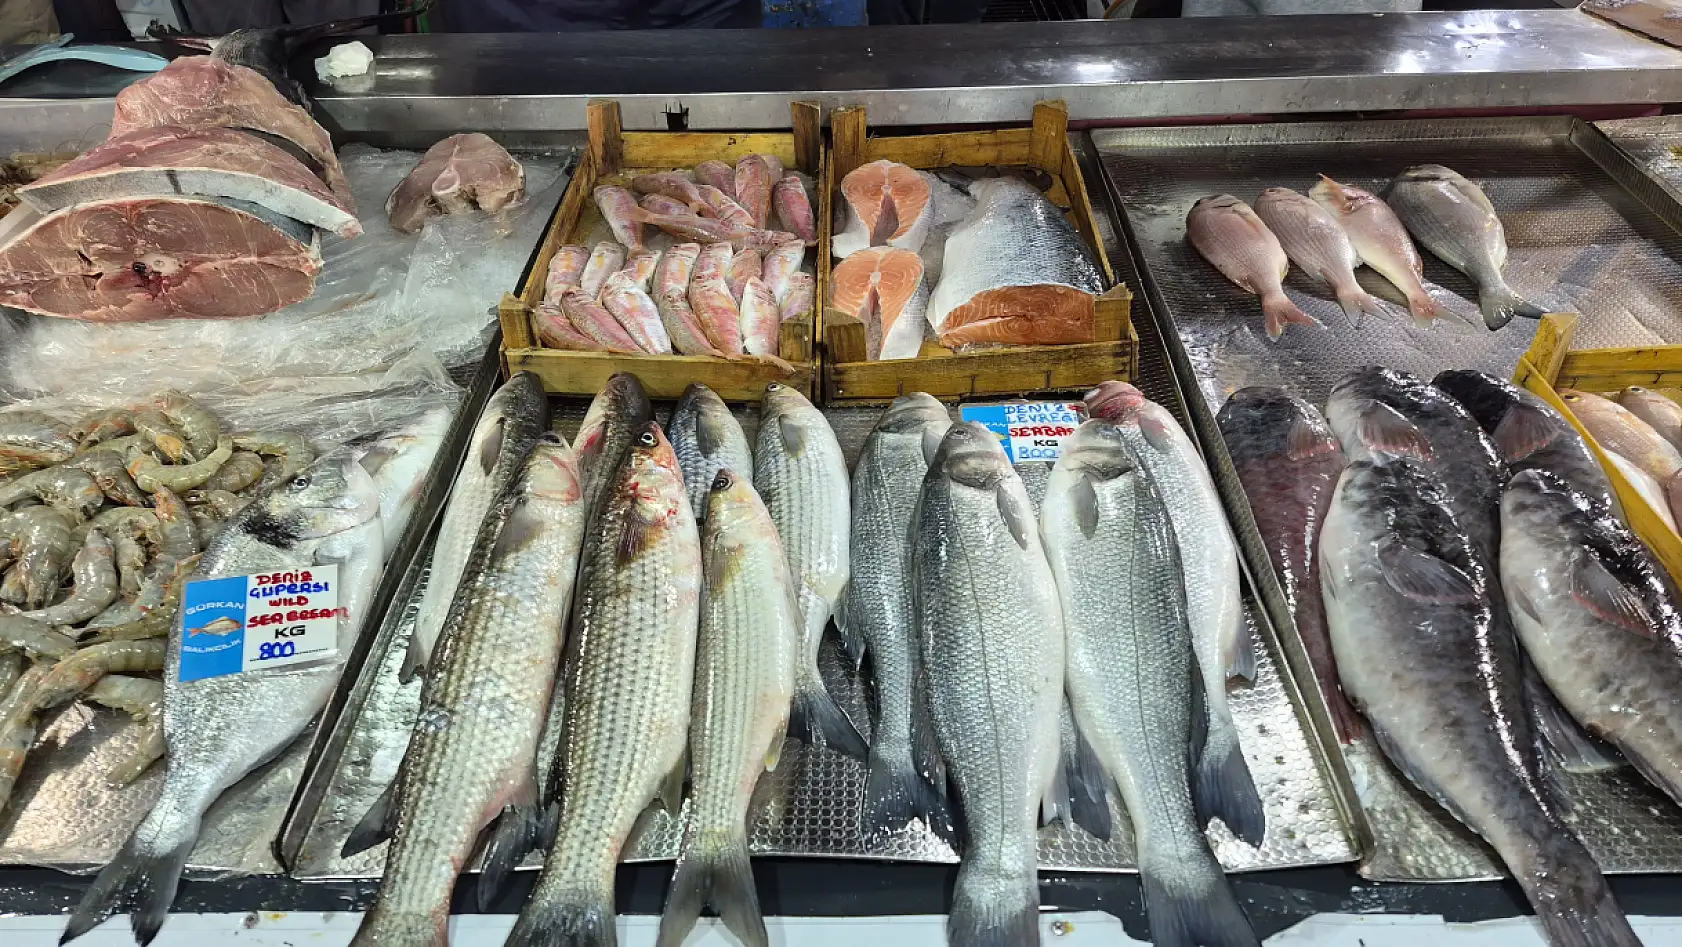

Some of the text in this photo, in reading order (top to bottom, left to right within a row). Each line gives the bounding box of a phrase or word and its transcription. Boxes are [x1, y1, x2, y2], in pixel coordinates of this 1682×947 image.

[268, 595, 309, 607] WILD
[274, 625, 306, 639] KG
[259, 641, 295, 660] 800
